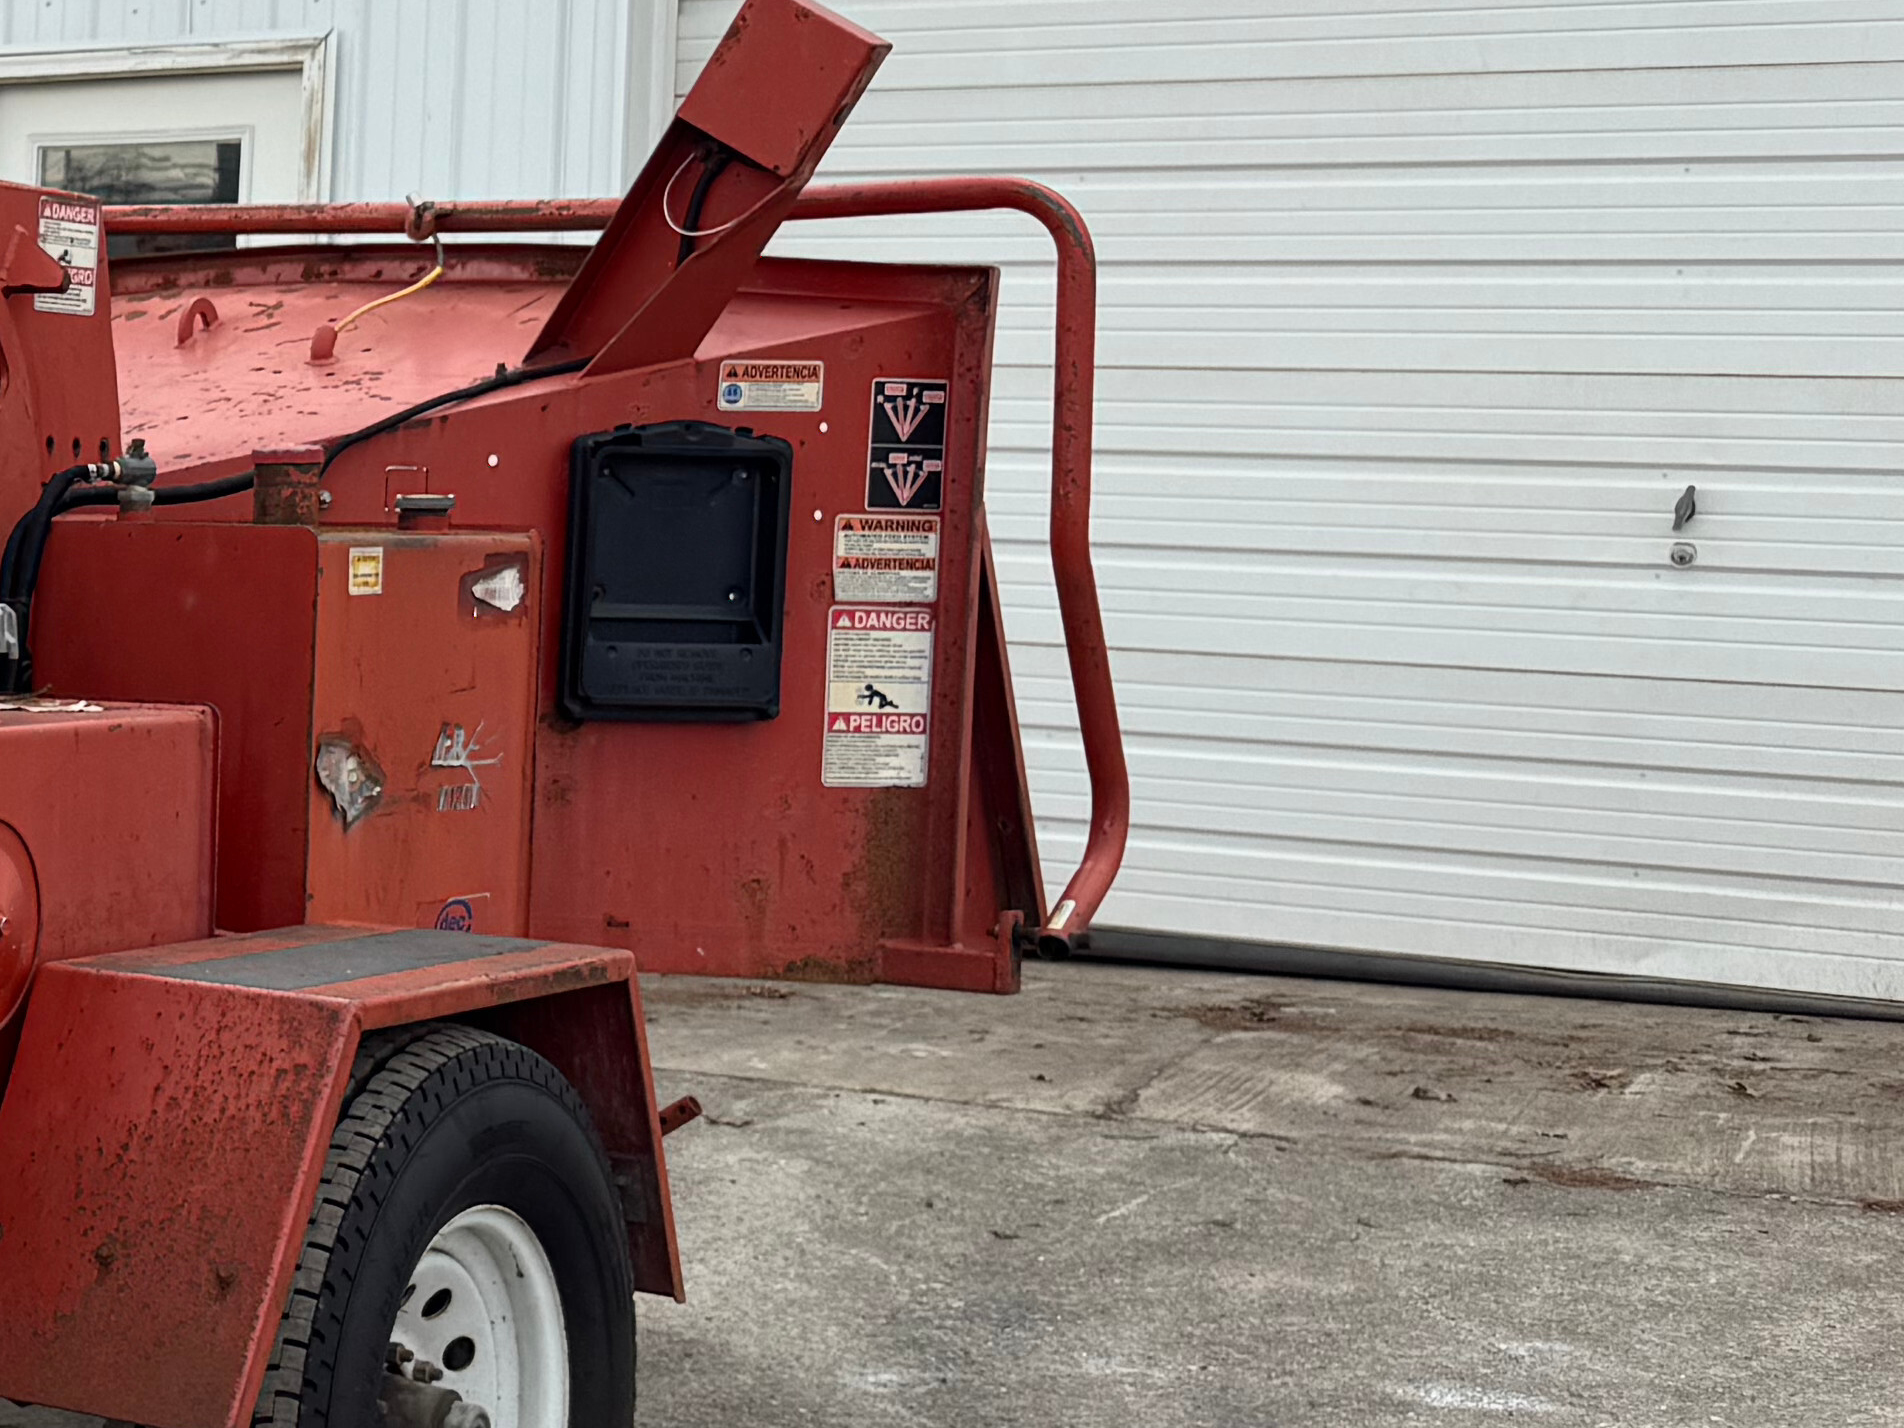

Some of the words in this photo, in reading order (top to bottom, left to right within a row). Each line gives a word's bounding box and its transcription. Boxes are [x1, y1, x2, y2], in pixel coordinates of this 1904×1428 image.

[51, 203, 95, 223] DANGER
[742, 365, 819, 379] ADVERTENCIA
[860, 519, 933, 532] WARNING
[853, 558, 933, 571] ADVERTENCIA
[854, 611, 930, 630] DANGER
[849, 714, 925, 733] PELIGRO
